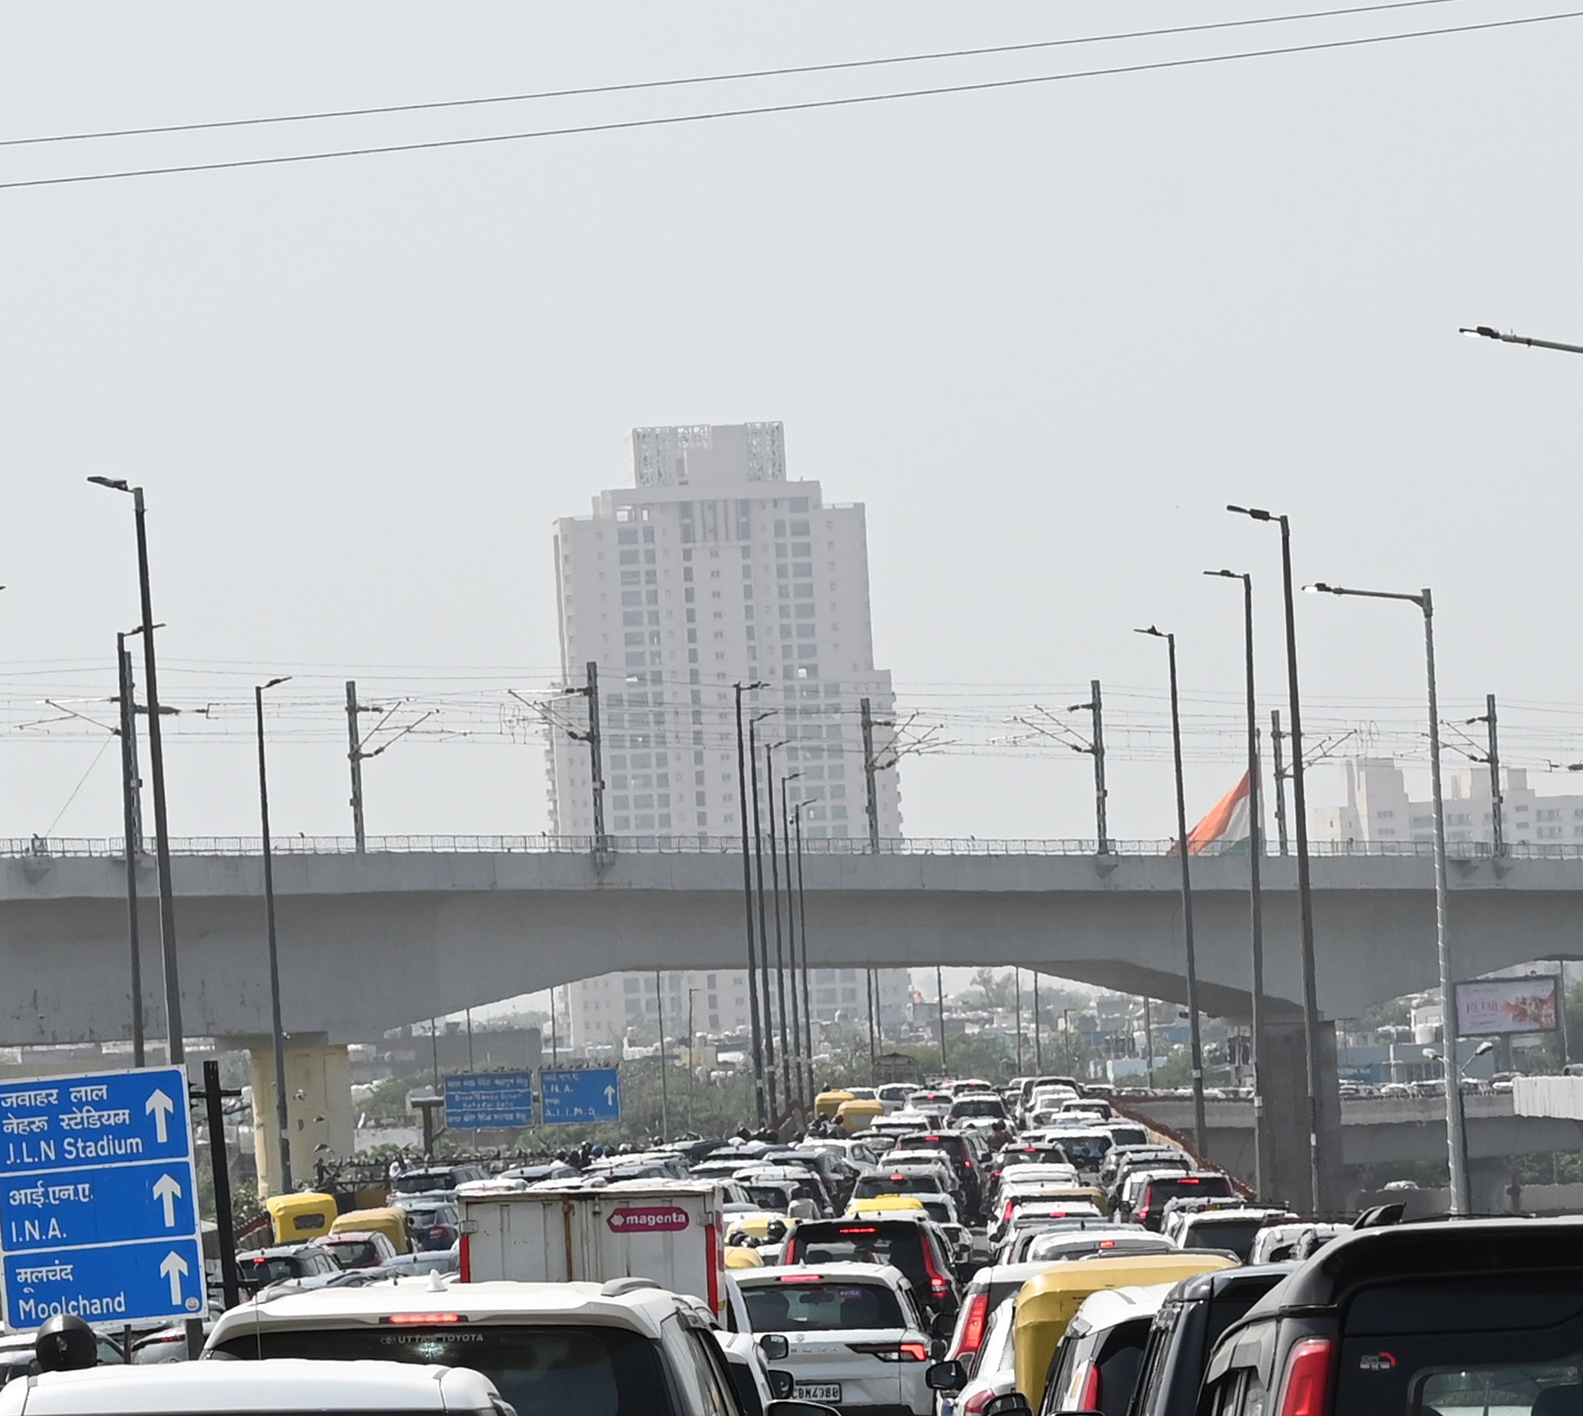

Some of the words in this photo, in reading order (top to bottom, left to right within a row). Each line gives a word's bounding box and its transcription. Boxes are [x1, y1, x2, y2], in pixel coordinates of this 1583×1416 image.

[0, 1088, 59, 1109] जवाहर
[69, 1085, 108, 1103] लाल
[2, 1113, 49, 1135] नेहरू
[59, 1105, 130, 1131] स्टेडियम
[6, 1139, 56, 1165] J.L.N
[64, 1135, 143, 1159] Stadium
[11, 1217, 67, 1243] I.N.A.
[626, 1212, 686, 1226] magenta
[16, 1259, 73, 1294] मूलचंद
[19, 1291, 126, 1321] Moolchand
[442, 1333, 484, 1342] TOYOTA
